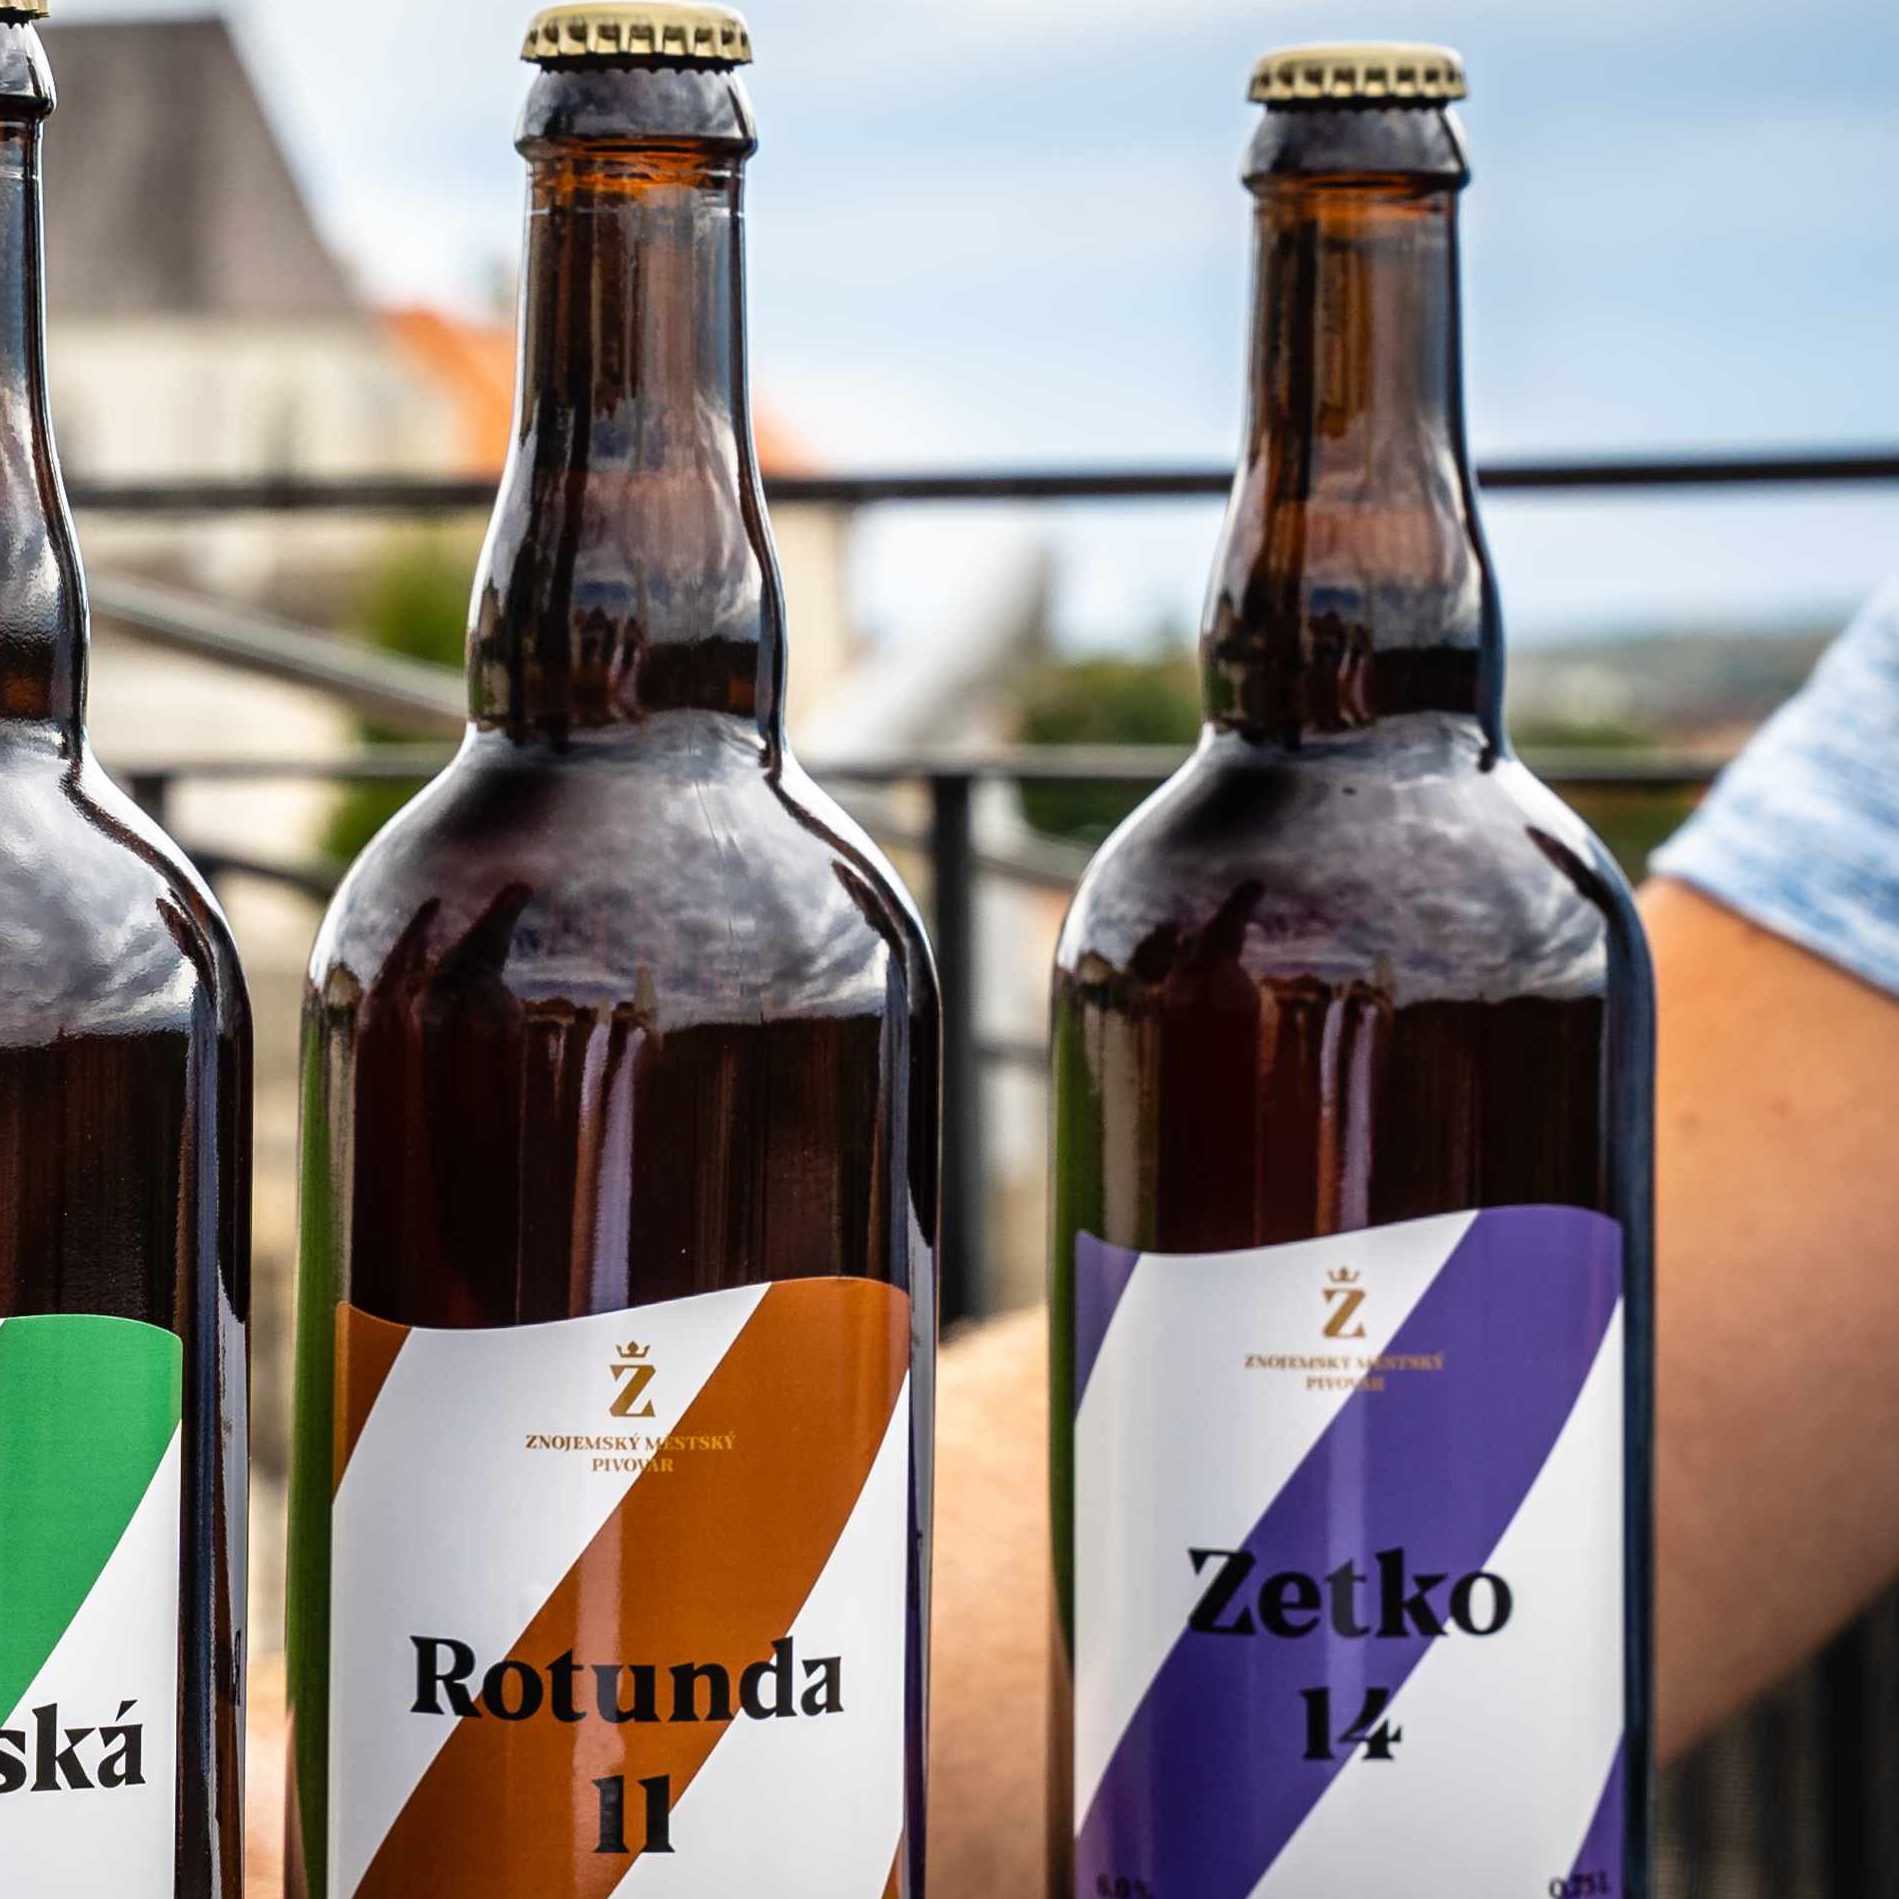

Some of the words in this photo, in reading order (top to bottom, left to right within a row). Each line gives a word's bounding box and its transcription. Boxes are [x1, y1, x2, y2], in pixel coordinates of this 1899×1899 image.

[525, 1432, 640, 1453] ZNOJEMSKÝ
[645, 1431, 737, 1451] MĚSTSKÝ
[592, 1457, 675, 1473] PIVOVAR
[1187, 1546, 1514, 1639] Zetko
[409, 1635, 845, 1724] Rotunda
[1299, 1686, 1404, 1762] 14
[591, 1774, 676, 1854] 11
